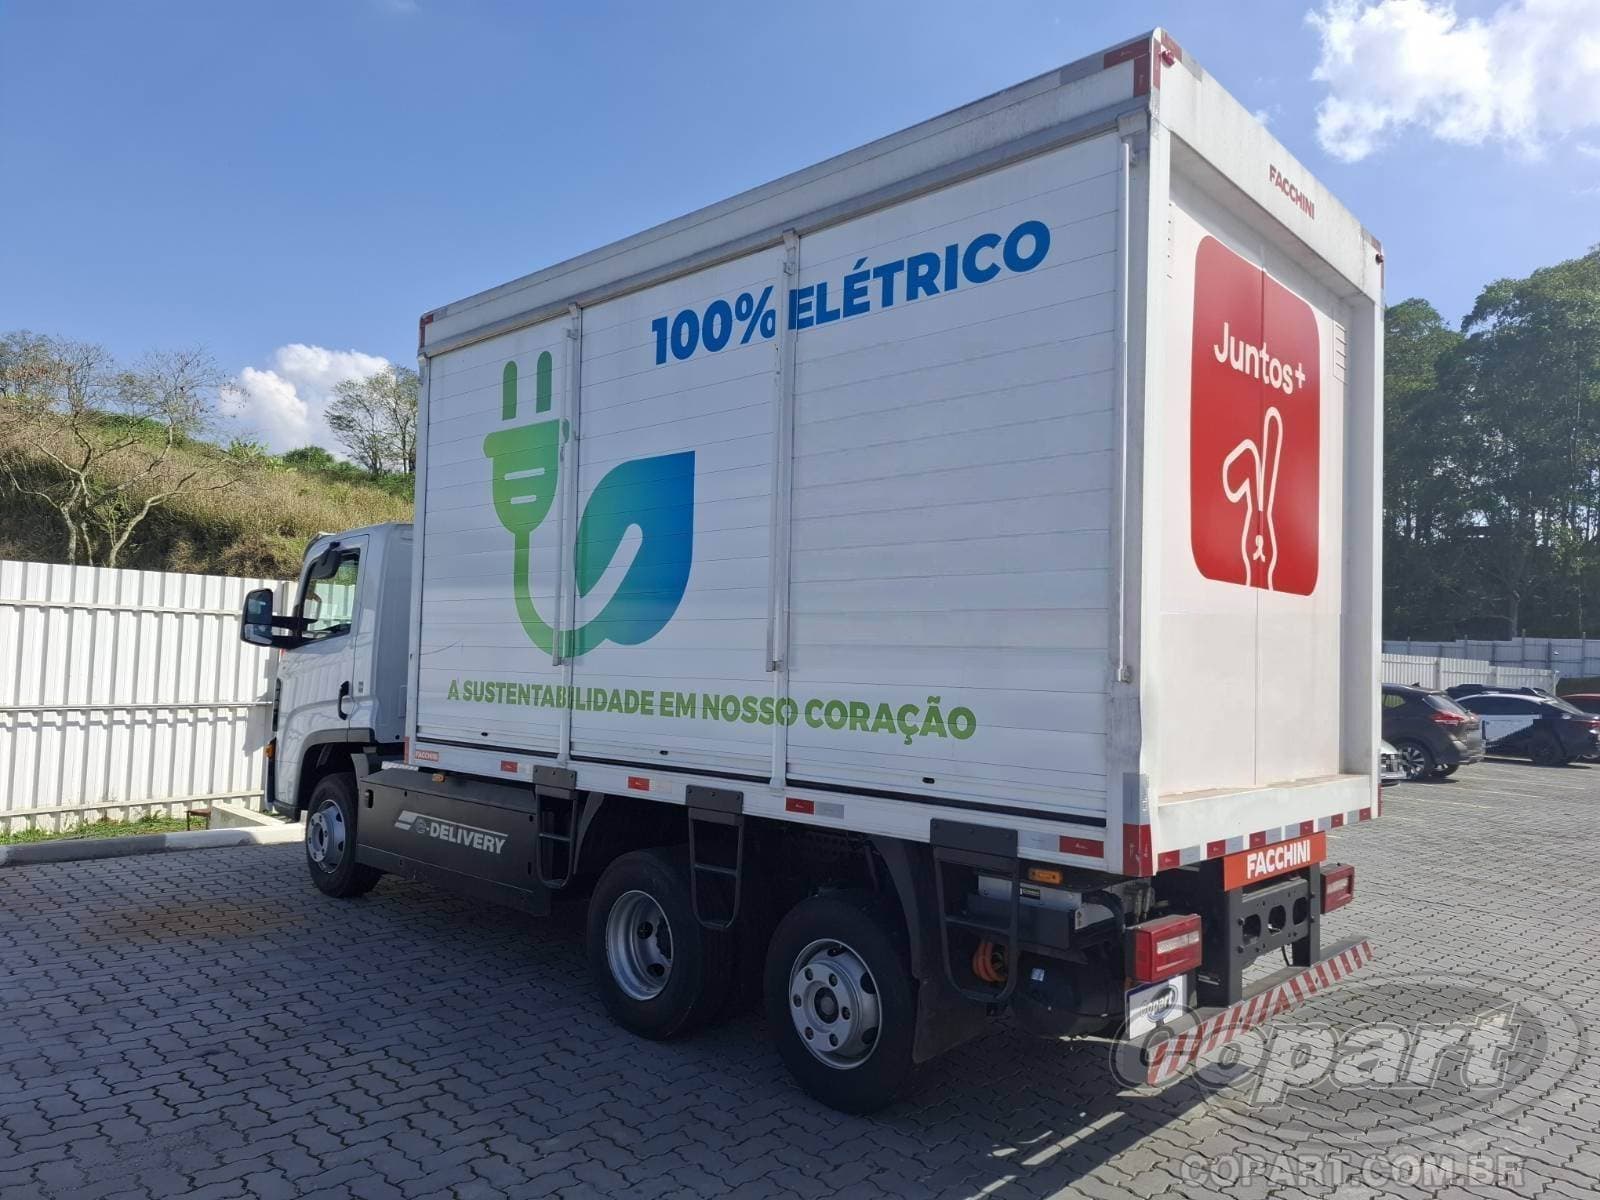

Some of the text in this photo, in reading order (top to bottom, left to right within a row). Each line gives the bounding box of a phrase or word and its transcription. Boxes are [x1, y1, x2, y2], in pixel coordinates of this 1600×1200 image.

[1269, 164, 1315, 219] FACCHINI
[651, 220, 1051, 366] 100% ELÉTRICO
[448, 680, 977, 745] A SUSTENTABILIDADE EM NOSSO CORAÇÃO
[1247, 839, 1311, 880] FACCHINI
